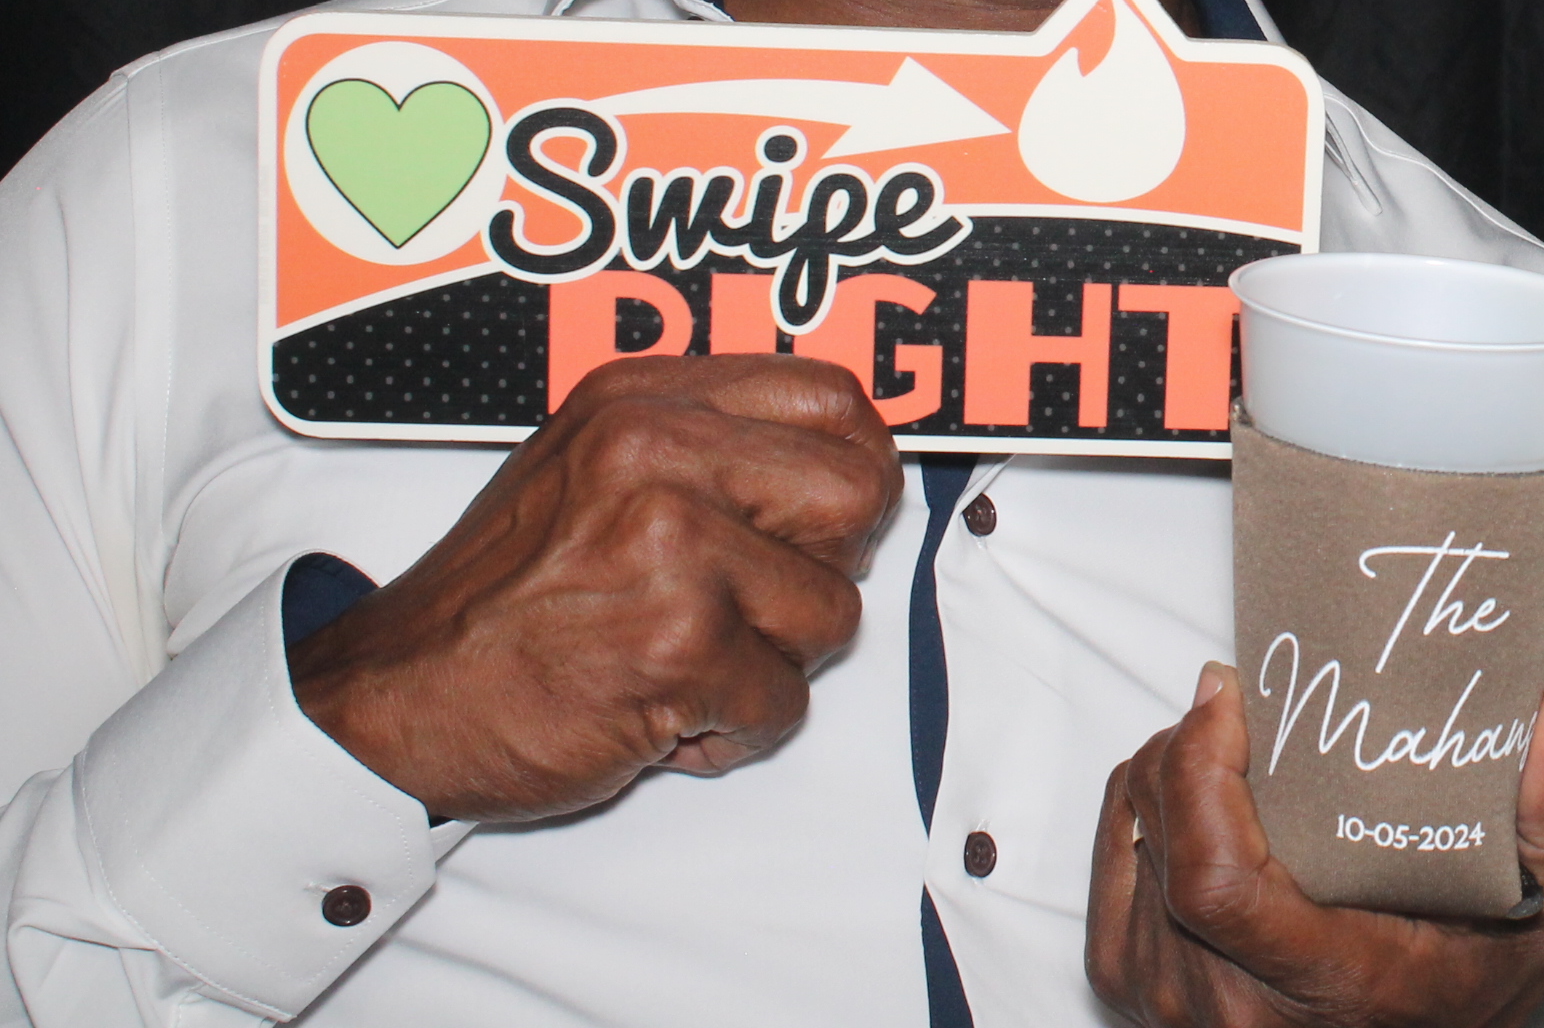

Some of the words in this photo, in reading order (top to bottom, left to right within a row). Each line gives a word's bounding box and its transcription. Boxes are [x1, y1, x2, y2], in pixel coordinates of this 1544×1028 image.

[488, 104, 969, 329] Swipe
[1357, 529, 1511, 674] The
[1335, 813, 1486, 851] 10-05-2024
